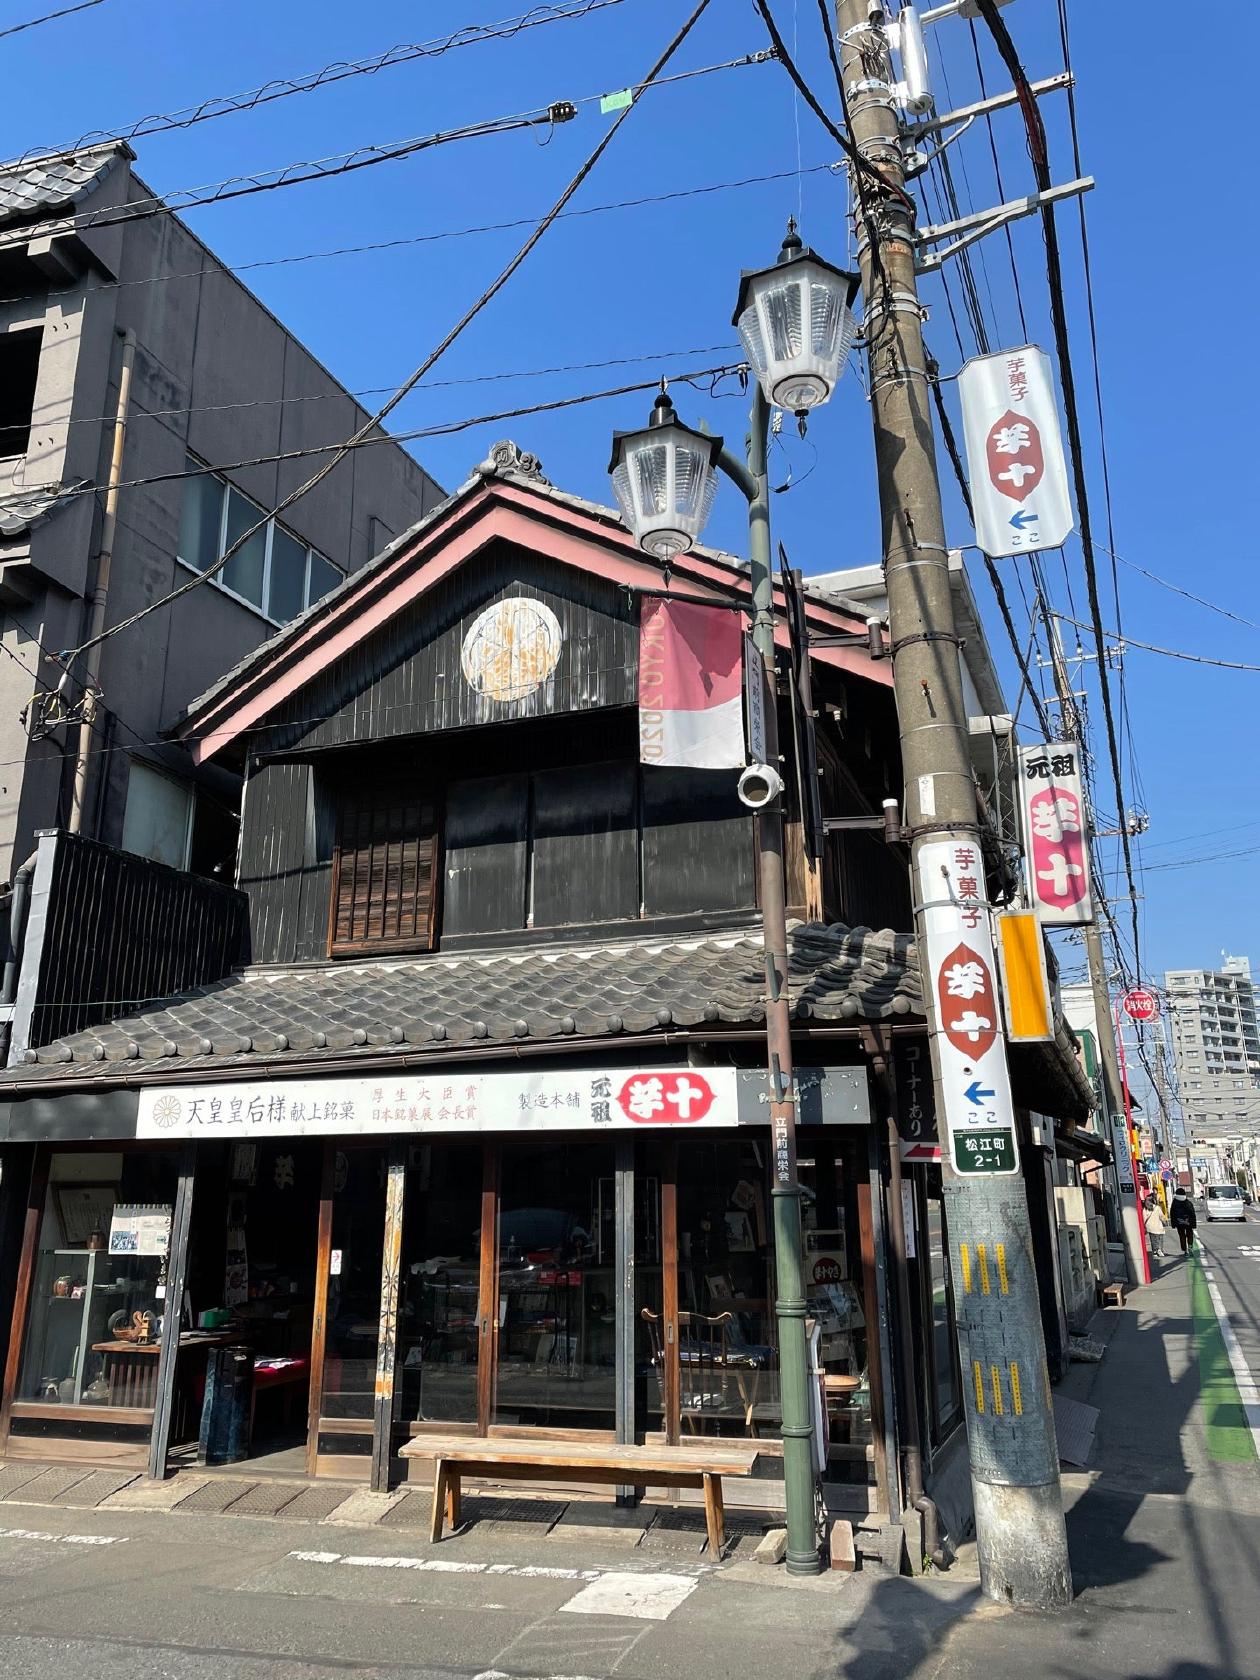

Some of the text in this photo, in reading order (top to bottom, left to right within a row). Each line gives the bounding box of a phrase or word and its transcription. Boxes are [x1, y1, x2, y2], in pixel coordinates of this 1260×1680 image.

[1007, 357, 1029, 402] 芋菓子
[992, 423, 1036, 487] 芋十
[1012, 532, 1040, 546] ここ
[1026, 753, 1076, 779] 元祖
[1032, 797, 1083, 897] 芋十
[954, 847, 983, 929] 芋菓子
[944, 961, 991, 1042] 芋十
[1126, 999, 1152, 1012] 消火栓
[372, 1085, 479, 1103] 厚生大臣賞
[518, 1091, 580, 1110] 製造本舗
[591, 1076, 613, 1123] 元祖
[903, 1045, 923, 1137] コーナーあり
[968, 1111, 998, 1124] ここ
[775, 1116, 791, 1182] 立門前商栄会
[965, 1137, 1005, 1152] 松江町
[974, 1154, 1001, 1167] 2-1
